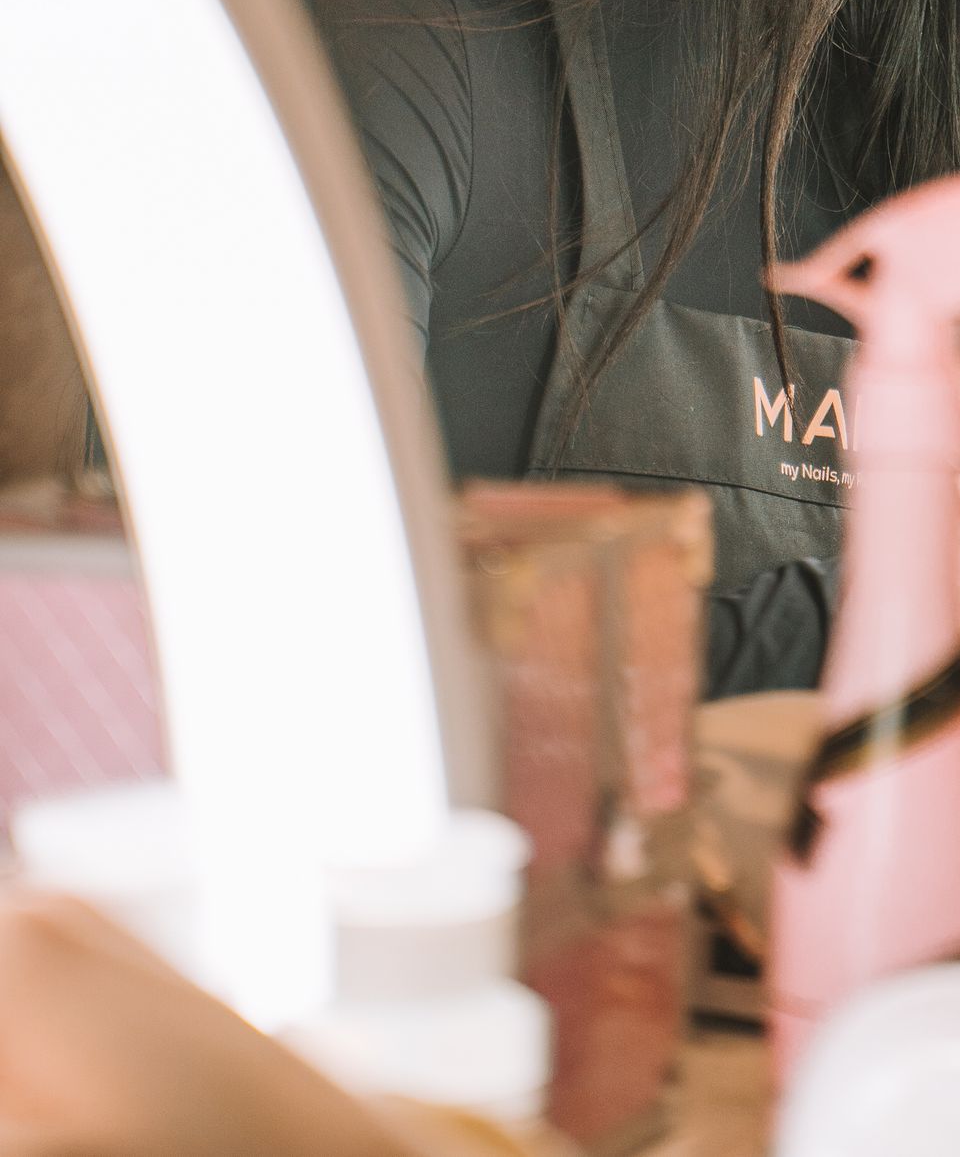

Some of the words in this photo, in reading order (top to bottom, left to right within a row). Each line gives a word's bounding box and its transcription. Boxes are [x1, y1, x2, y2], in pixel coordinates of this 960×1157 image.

[754, 377, 861, 452] MA
[781, 462, 799, 481] my
[802, 462, 840, 486] Nails,
[841, 472, 854, 489] my
